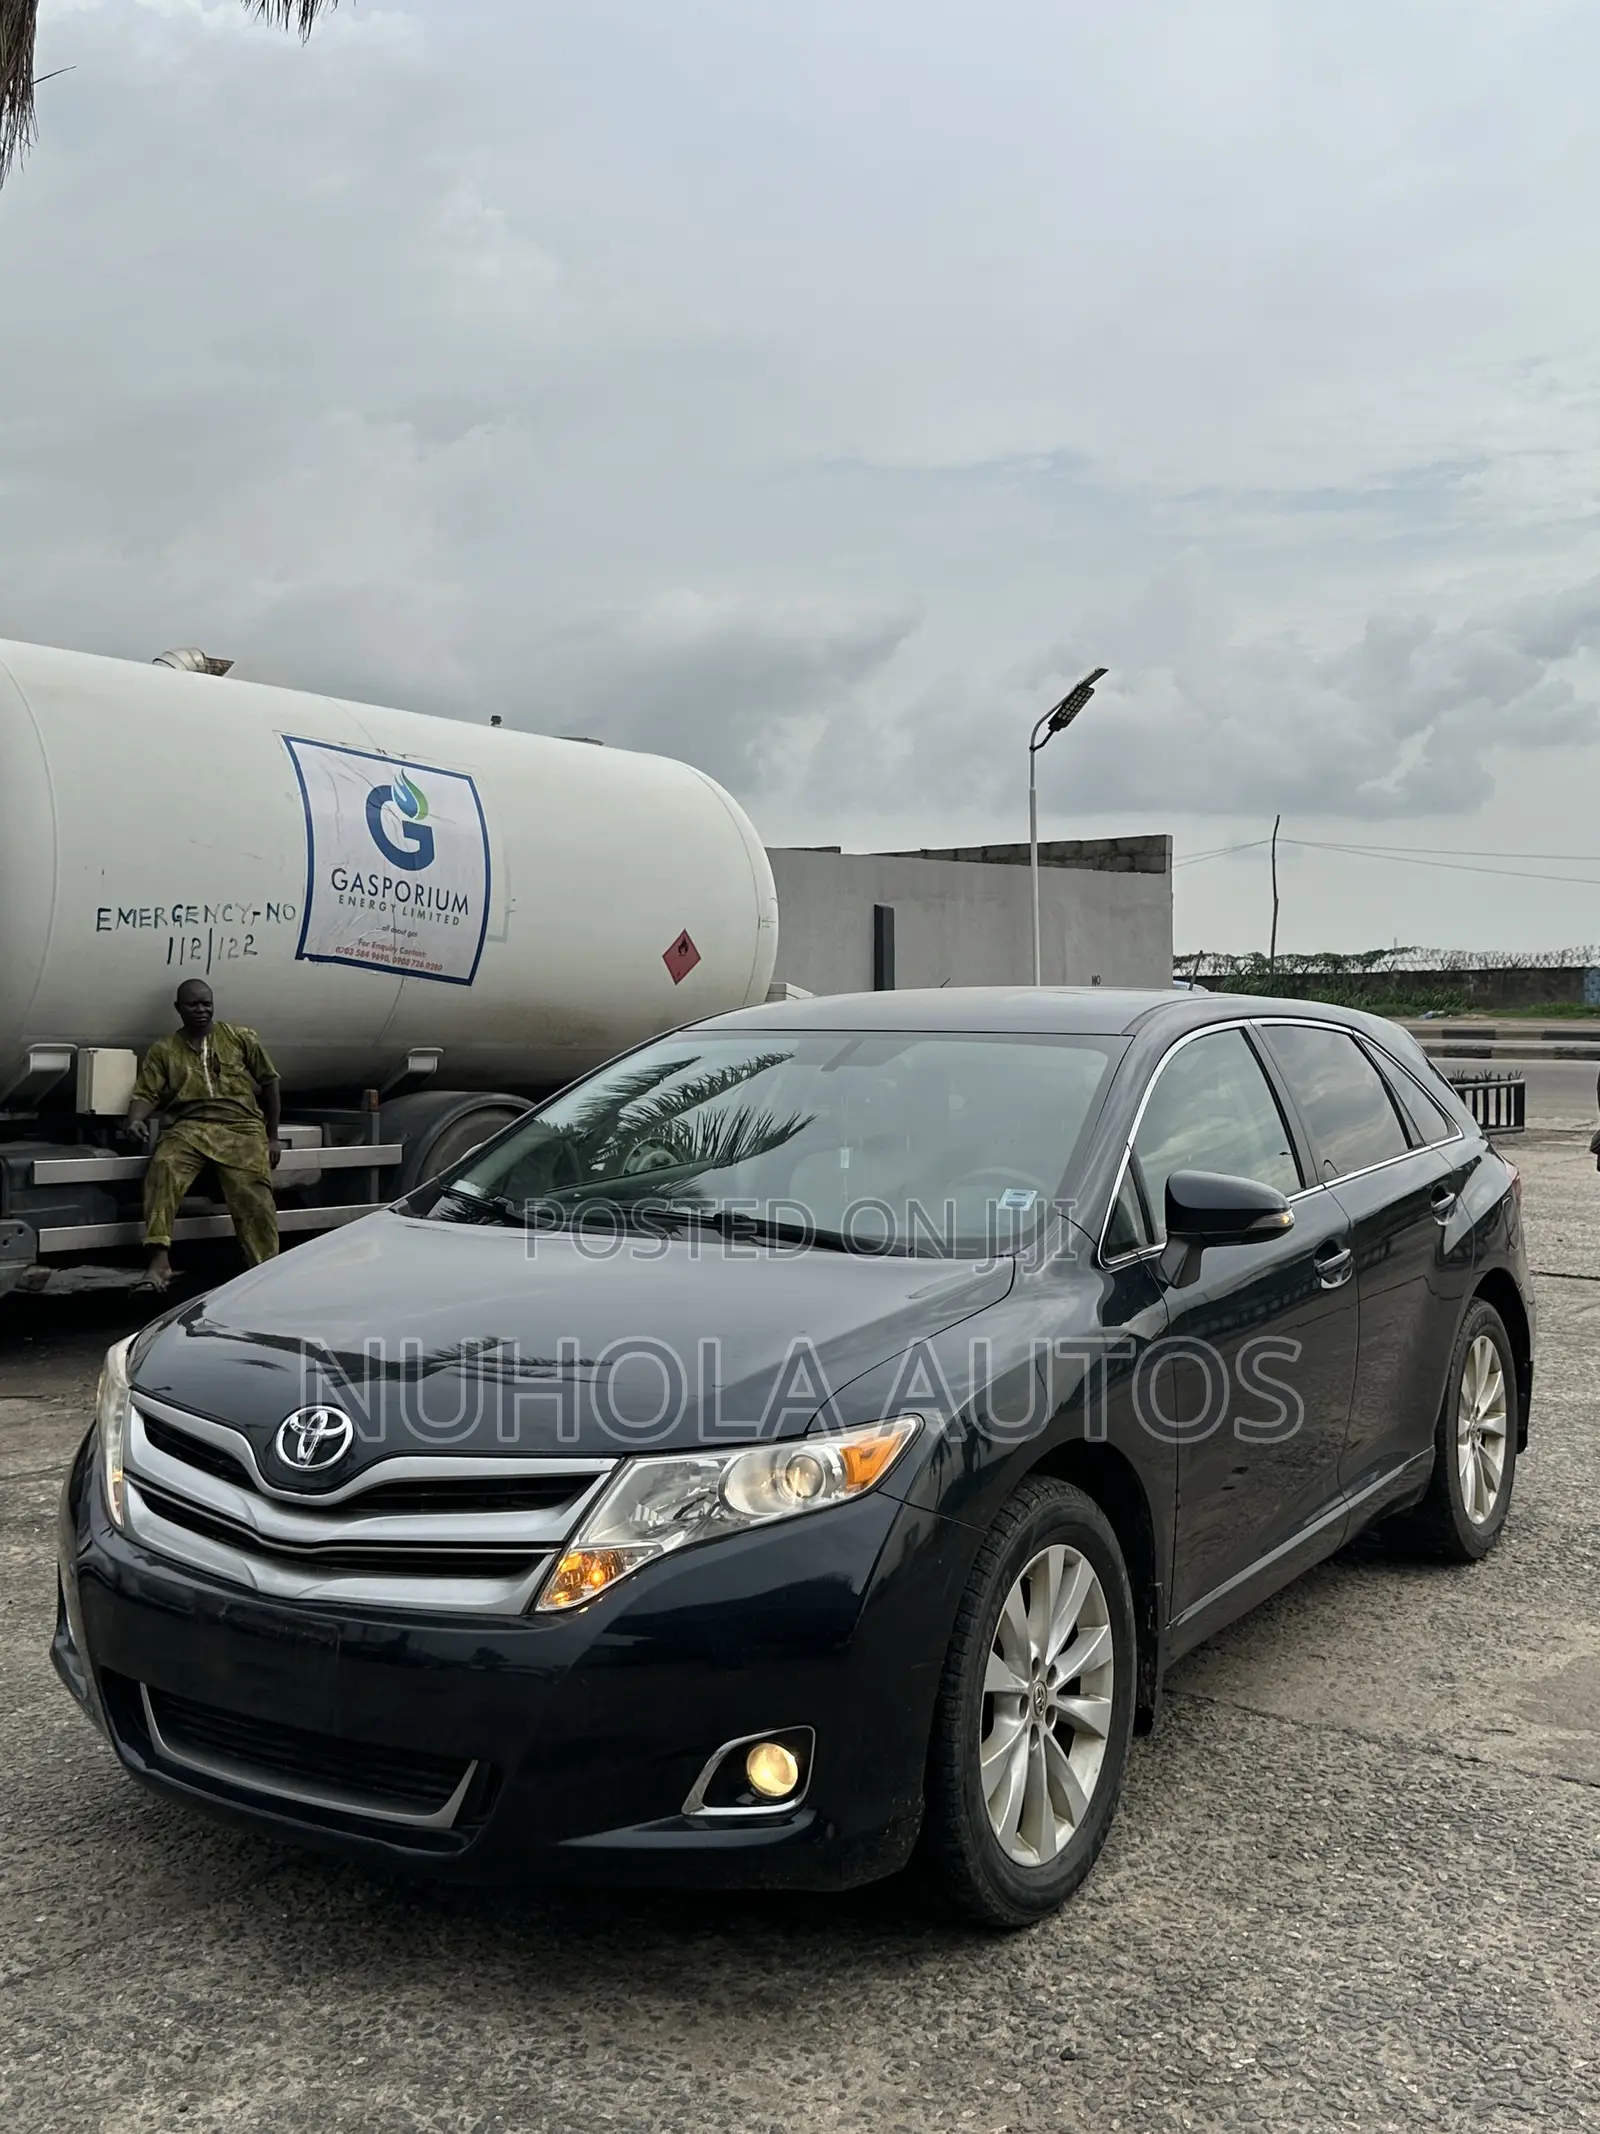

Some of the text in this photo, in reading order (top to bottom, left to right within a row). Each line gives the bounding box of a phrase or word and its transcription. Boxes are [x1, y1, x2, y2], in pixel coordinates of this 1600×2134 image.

[331, 867, 469, 916] GASPORIUM
[338, 894, 460, 926] ENERGY LIMITED
[407, 930, 418, 938] gas
[358, 938, 428, 958] For Enquiry Contact:
